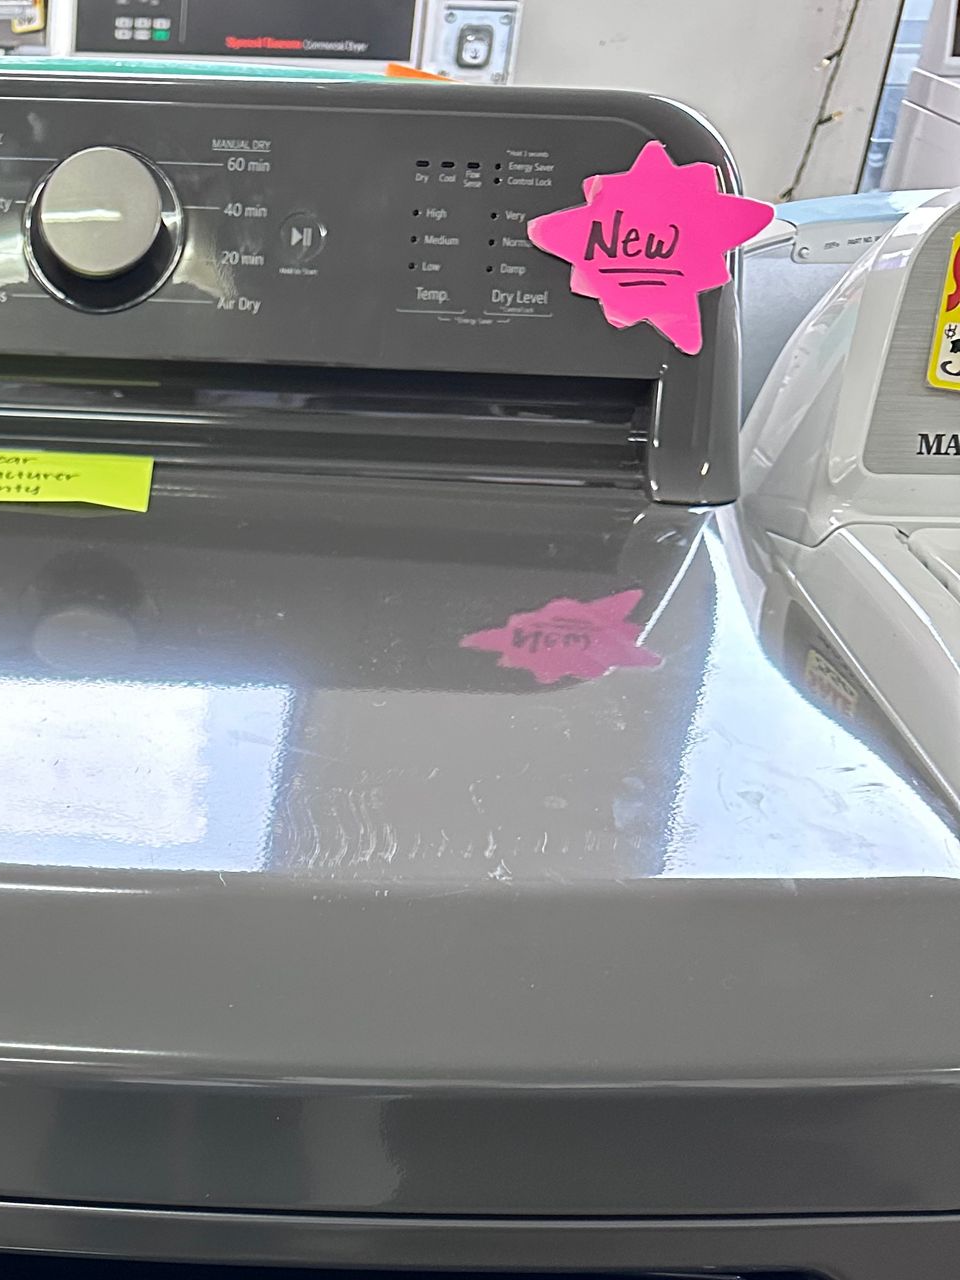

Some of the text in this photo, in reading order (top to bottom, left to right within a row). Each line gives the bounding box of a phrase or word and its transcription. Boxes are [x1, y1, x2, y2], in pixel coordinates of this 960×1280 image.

[212, 139, 271, 151] MANUAL DRY
[227, 157, 271, 172] 60 min
[509, 162, 555, 174] Energy Saver
[415, 173, 429, 184] Dry
[439, 174, 456, 183] Cool
[507, 177, 552, 187] Control Lock
[224, 203, 268, 218] 40 min
[426, 208, 447, 221] High
[505, 210, 526, 223] Very
[424, 235, 459, 246] Medium
[583, 209, 680, 261] New
[502, 237, 531, 248] Norm
[221, 251, 264, 266] 20 min
[422, 262, 440, 271] Low
[500, 263, 526, 276] Damp
[416, 286, 450, 304] Temp.
[491, 289, 549, 306] Dry Level
[217, 298, 261, 314] Air Dry
